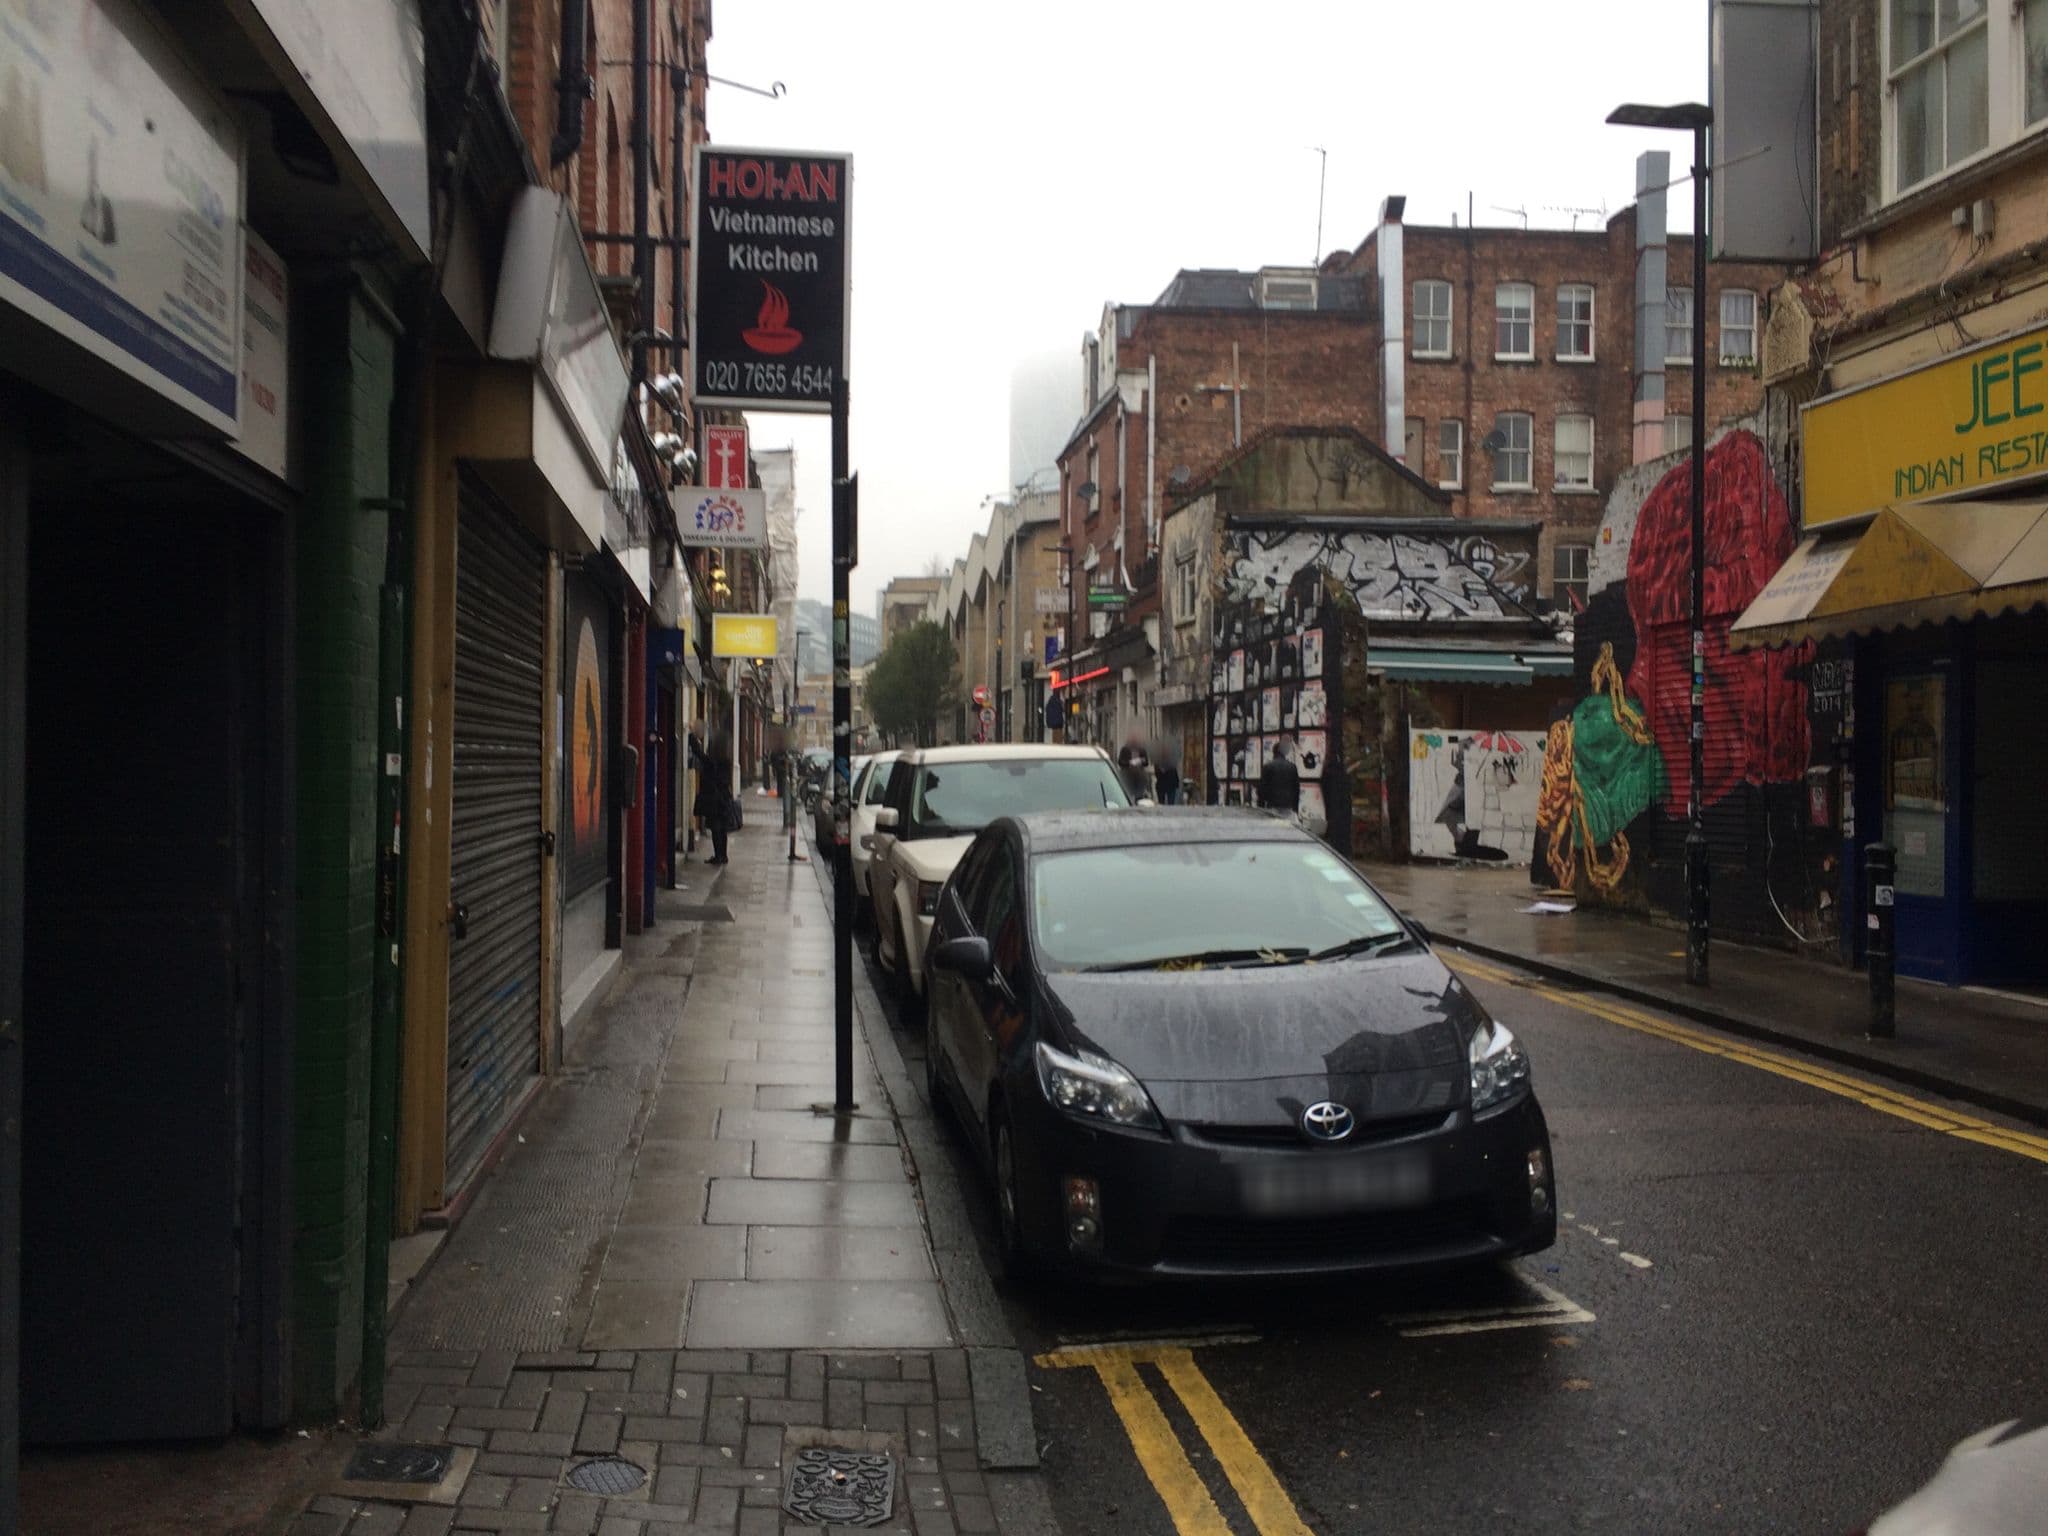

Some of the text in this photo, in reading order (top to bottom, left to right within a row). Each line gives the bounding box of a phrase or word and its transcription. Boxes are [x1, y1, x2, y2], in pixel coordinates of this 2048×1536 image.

[709, 206, 835, 237] Vietnamese
[728, 244, 818, 272] Kitchen
[706, 360, 832, 395] 020 7655 4544
[1955, 340, 2048, 435] JEE
[1895, 453, 1964, 499] INDIAN
